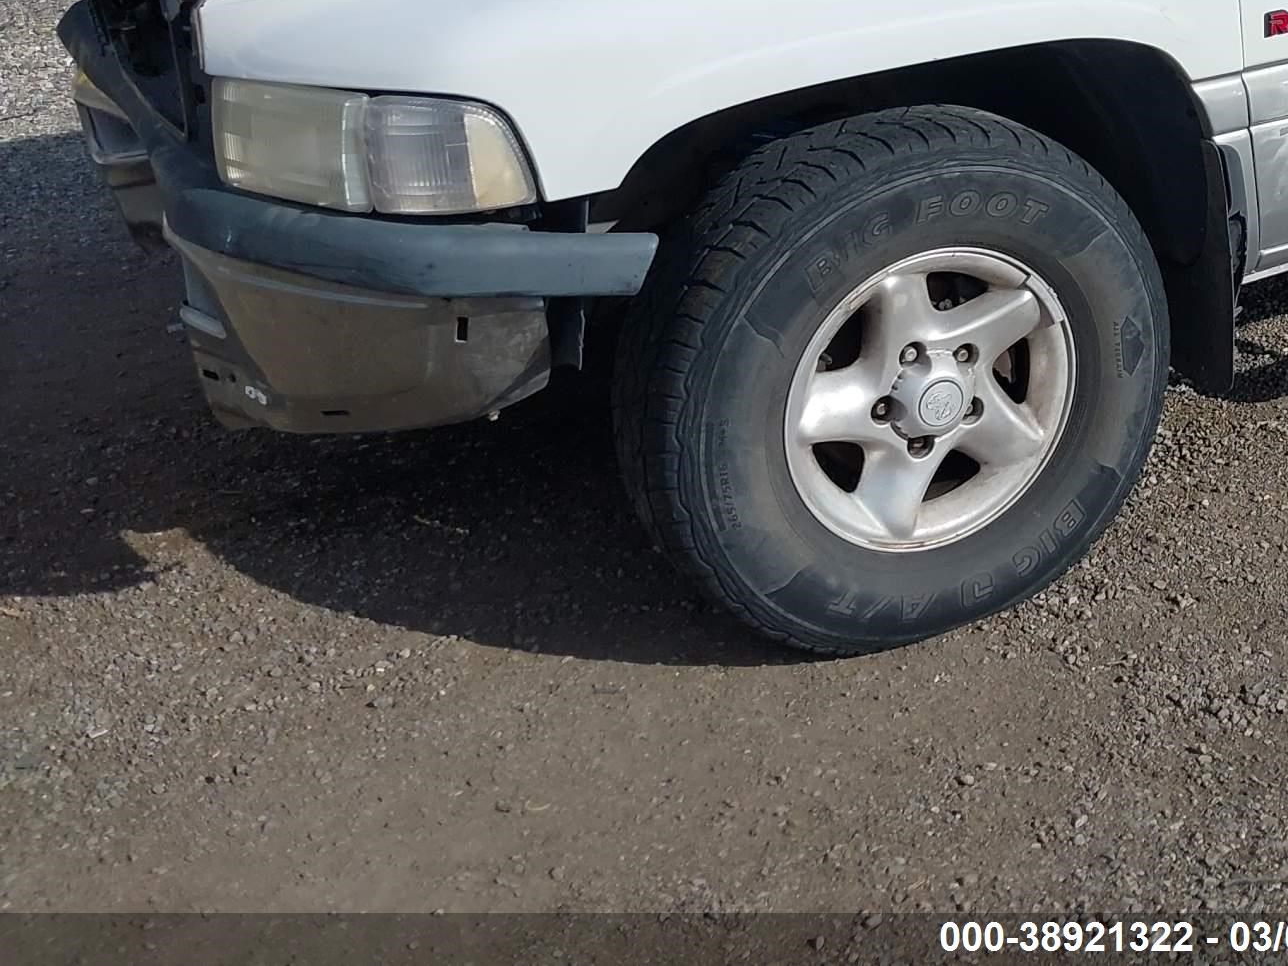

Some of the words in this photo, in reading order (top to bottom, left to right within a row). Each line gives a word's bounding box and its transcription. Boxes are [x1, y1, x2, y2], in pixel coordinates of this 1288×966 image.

[915, 188, 1050, 226] FOOT
[1011, 497, 1088, 577] BIG
[825, 592, 937, 622] A/T
